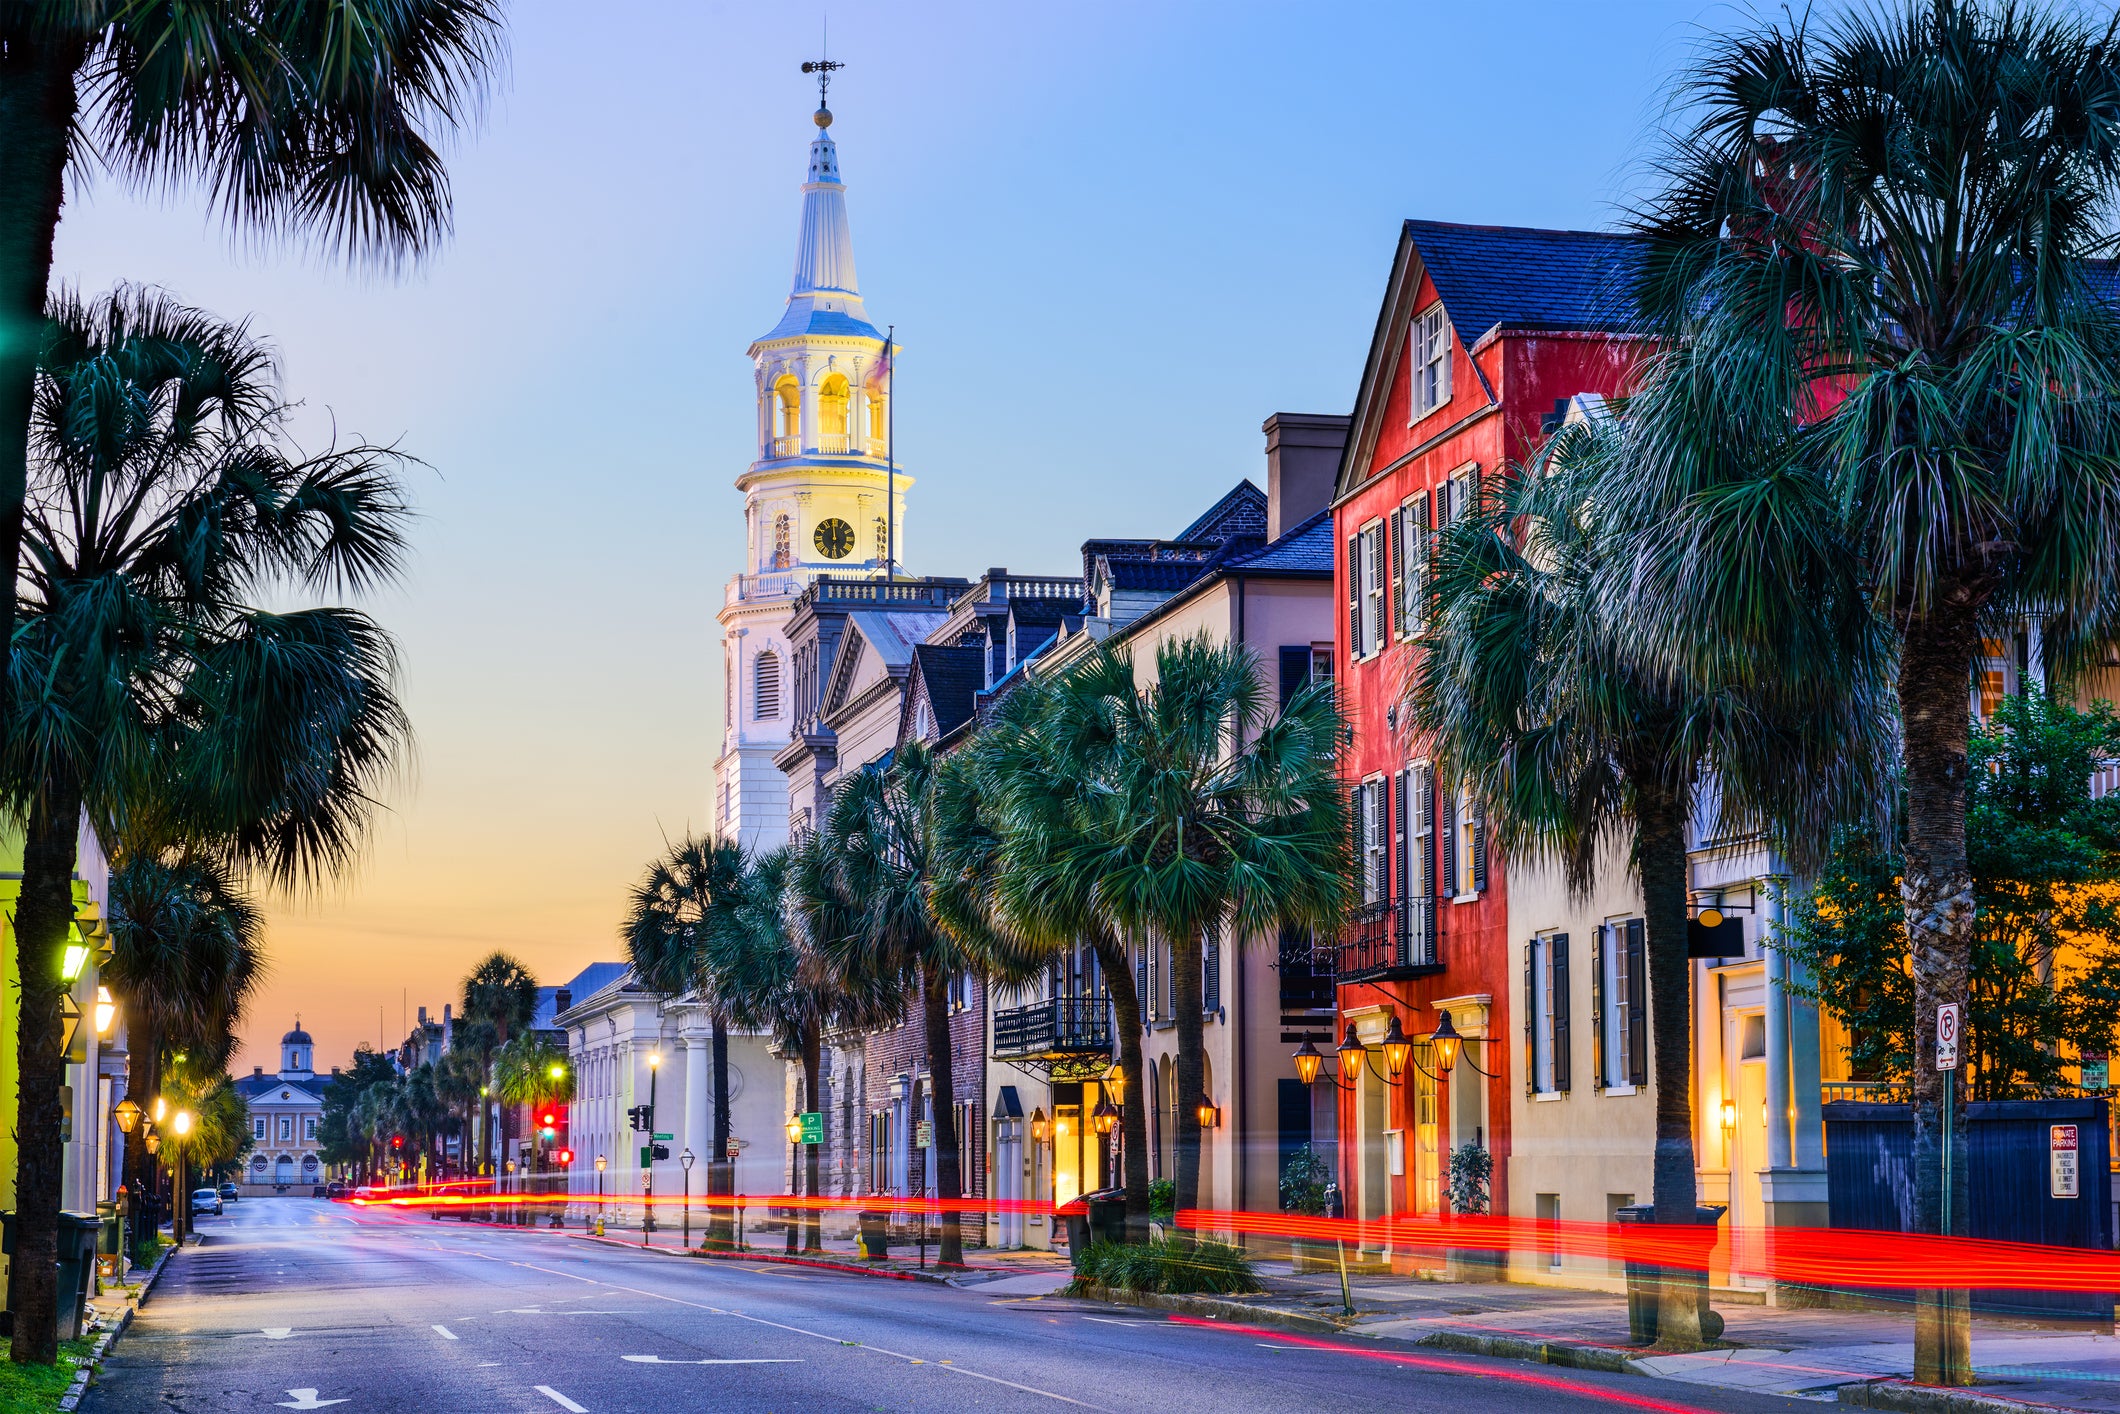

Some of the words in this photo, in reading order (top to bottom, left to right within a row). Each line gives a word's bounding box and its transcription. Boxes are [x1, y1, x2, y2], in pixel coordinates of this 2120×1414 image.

[808, 1116, 815, 1125] P
[2053, 1129, 2075, 1138] PRIVATE
[2053, 1138, 2076, 1147] PARKING
